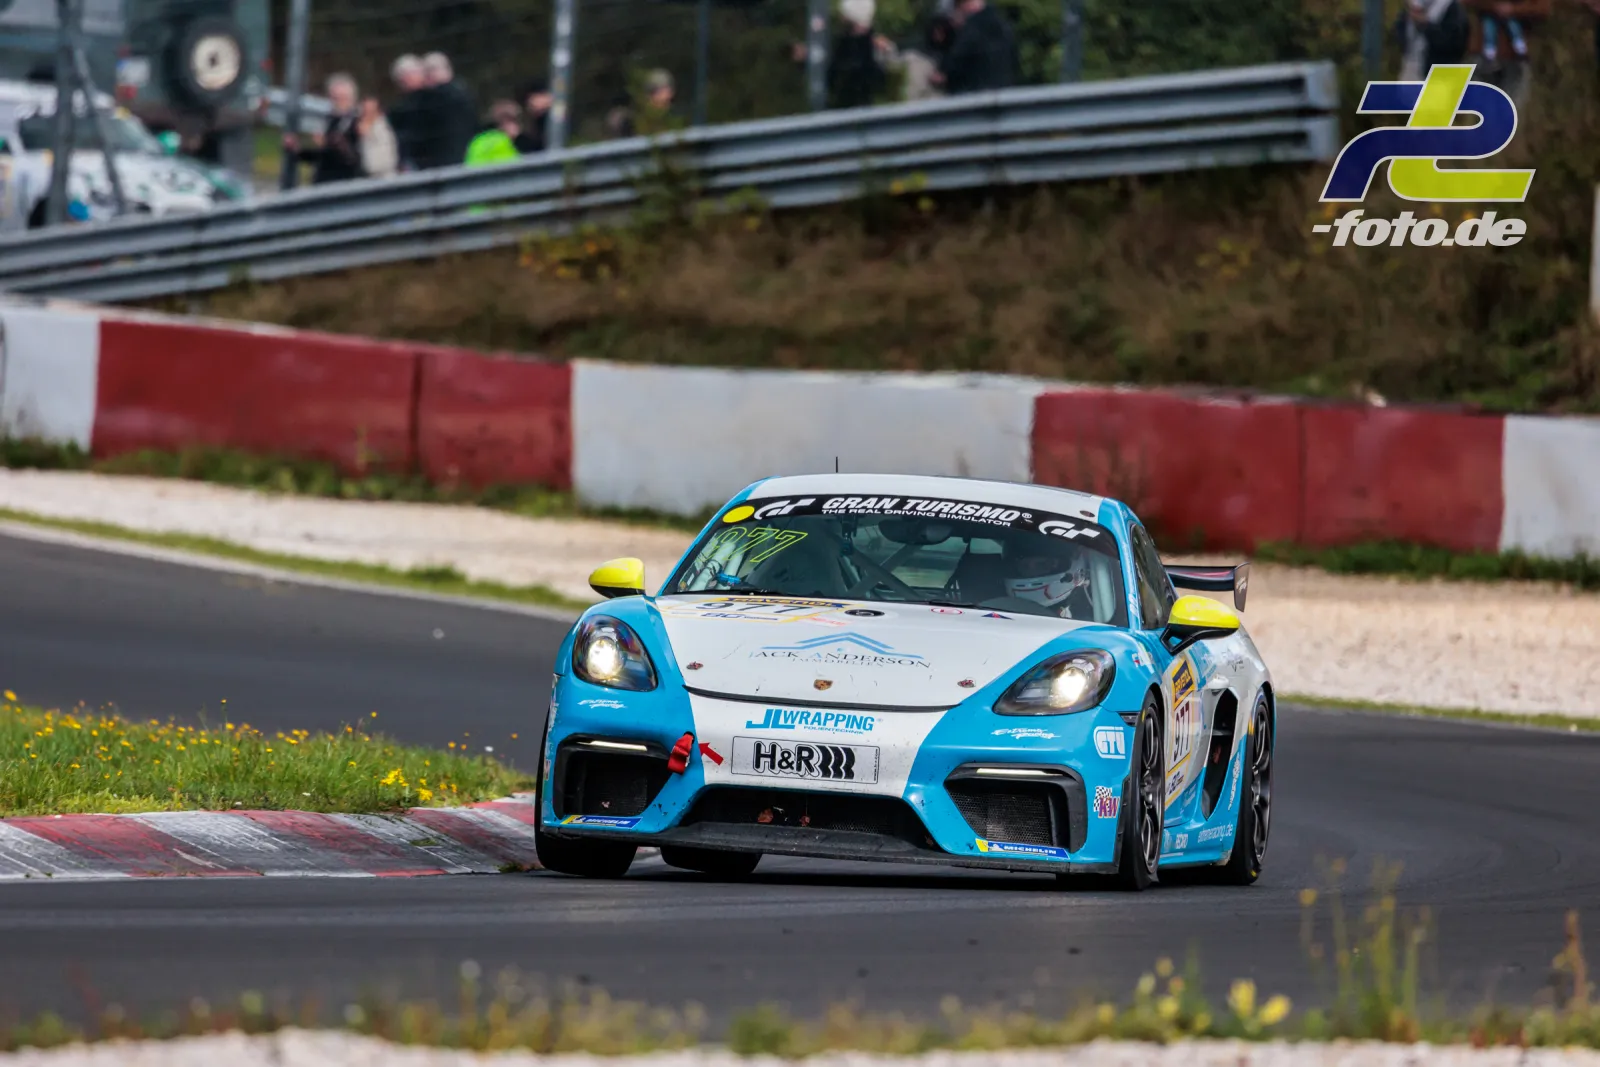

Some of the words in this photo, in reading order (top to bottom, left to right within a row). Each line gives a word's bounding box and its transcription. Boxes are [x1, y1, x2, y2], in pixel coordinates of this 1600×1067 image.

[822, 497, 900, 509] GRAN
[884, 509, 936, 517] DRIVING
[938, 512, 1011, 527] SIMULATOR
[697, 526, 809, 563] 977
[696, 602, 814, 614] 977
[808, 651, 931, 669] ANDERSON
[783, 710, 875, 731] WRAPPING
[1174, 701, 1190, 762] 977
[753, 741, 820, 777] H&R
[1098, 796, 1120, 818] KW
[1004, 845, 1057, 855] MICHELIN
